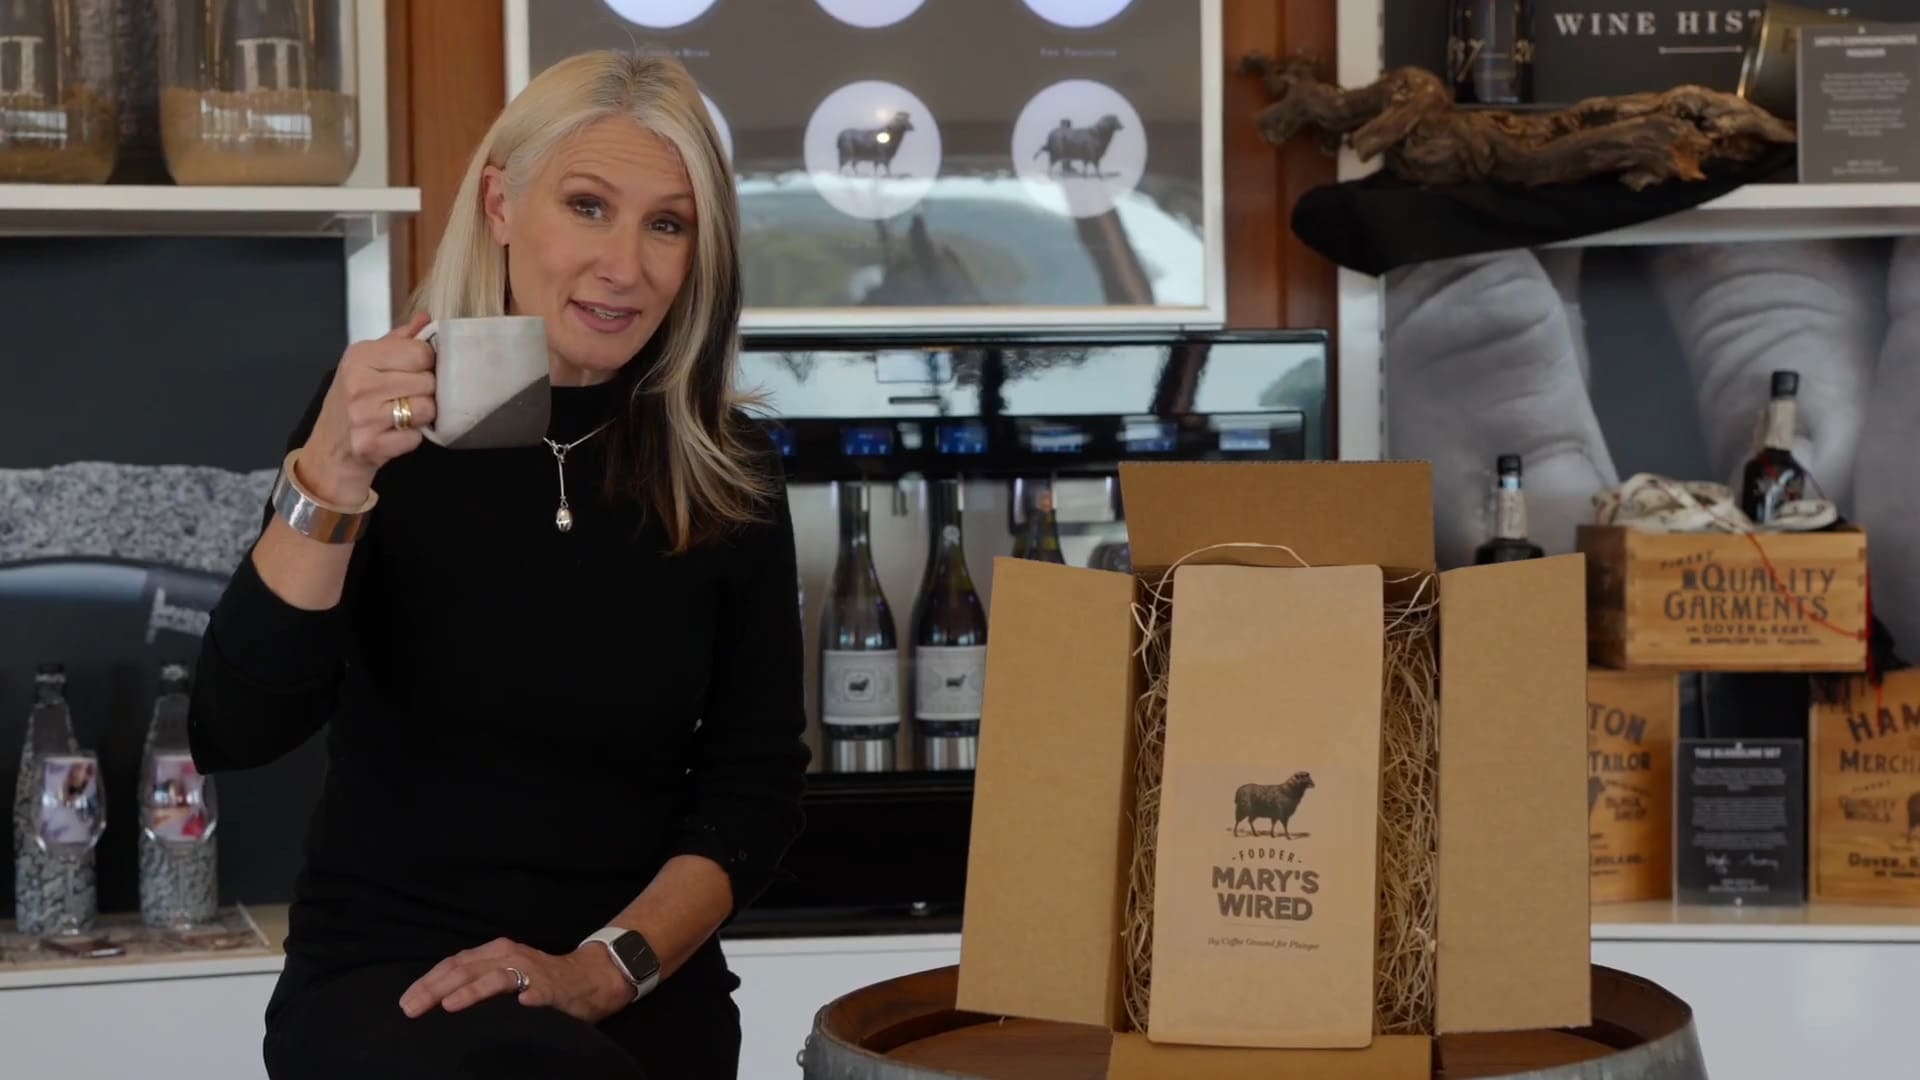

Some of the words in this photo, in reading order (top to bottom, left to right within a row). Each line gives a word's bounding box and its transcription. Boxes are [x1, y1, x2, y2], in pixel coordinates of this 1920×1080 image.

[1554, 12, 1656, 36] WINE
[1702, 563, 1836, 594] QUALITY
[1664, 591, 1828, 621] GARMENTS
[1590, 752, 1653, 772] TAILOR
[1840, 749, 1920, 774] MERCH
[1238, 847, 1296, 863] FODDER
[1211, 865, 1320, 895] MARY'S
[1217, 892, 1313, 921] WIRED
